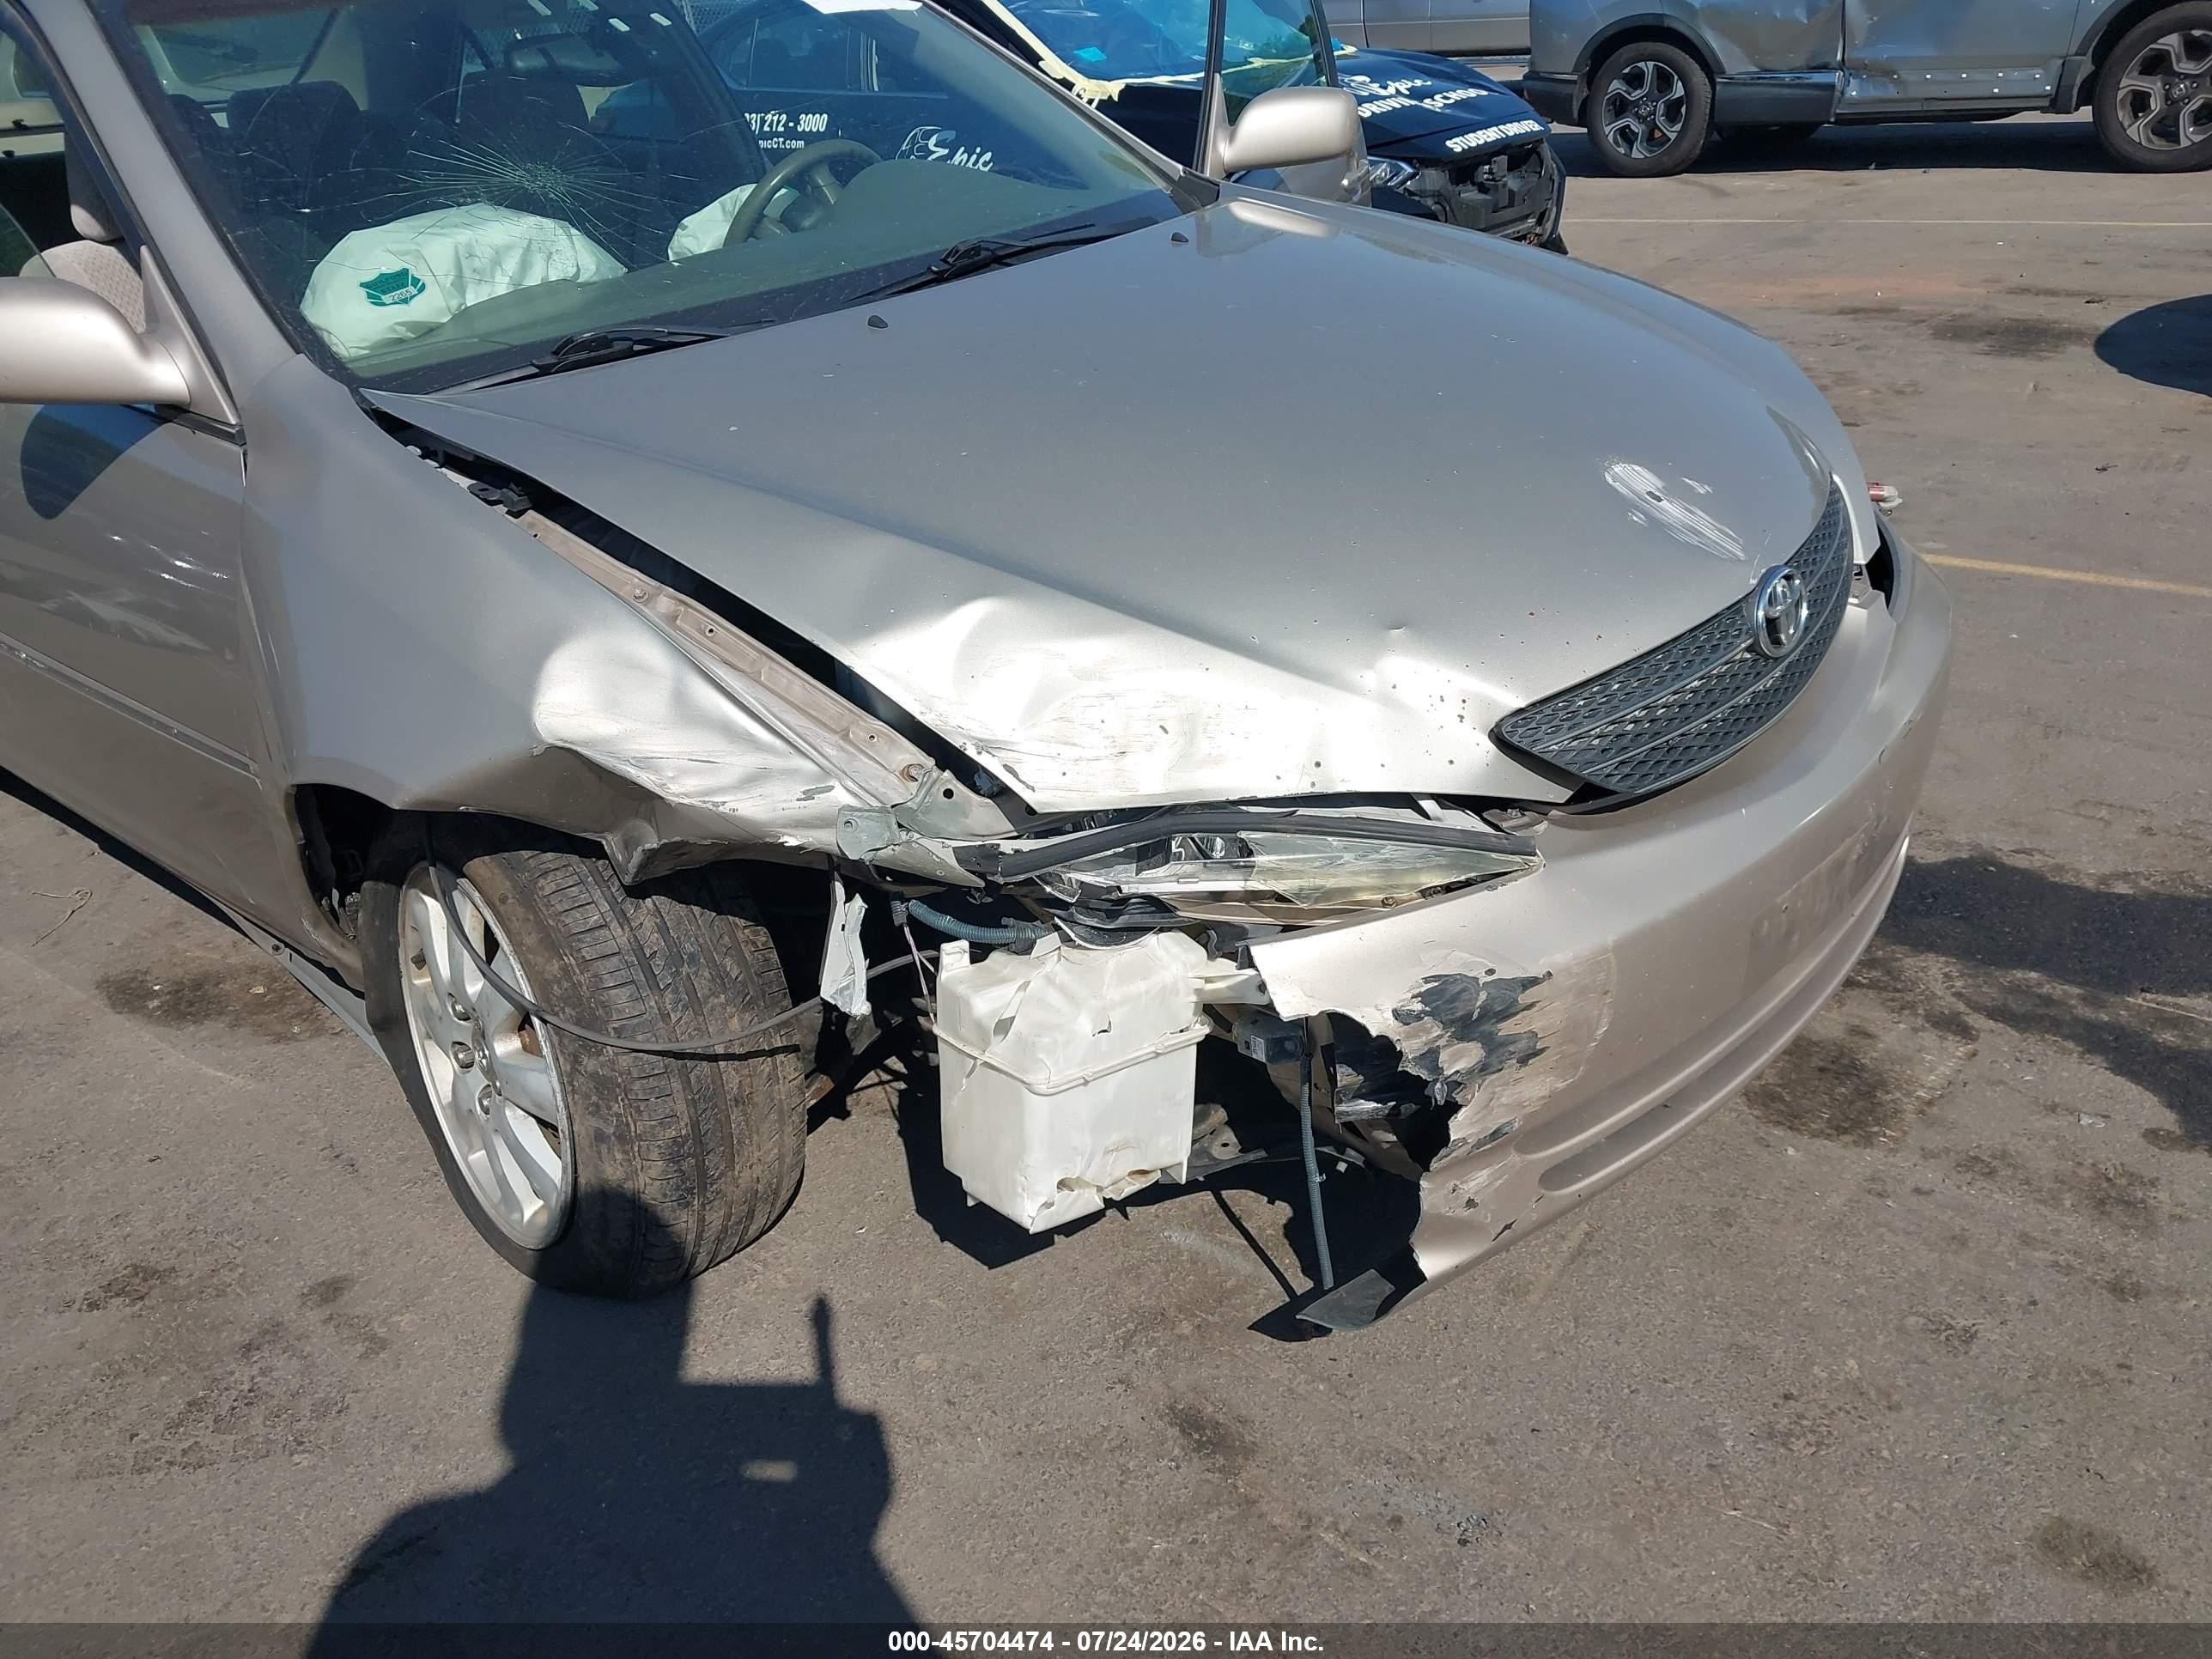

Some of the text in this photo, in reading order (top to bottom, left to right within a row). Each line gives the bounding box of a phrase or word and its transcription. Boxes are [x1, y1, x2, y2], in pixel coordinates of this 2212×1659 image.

[1423, 88, 1492, 108] SCHOO
[763, 112, 787, 131] 212
[797, 113, 828, 132] 3000
[1445, 125, 1506, 152] STUDENT
[389, 289, 413, 301] 2265
